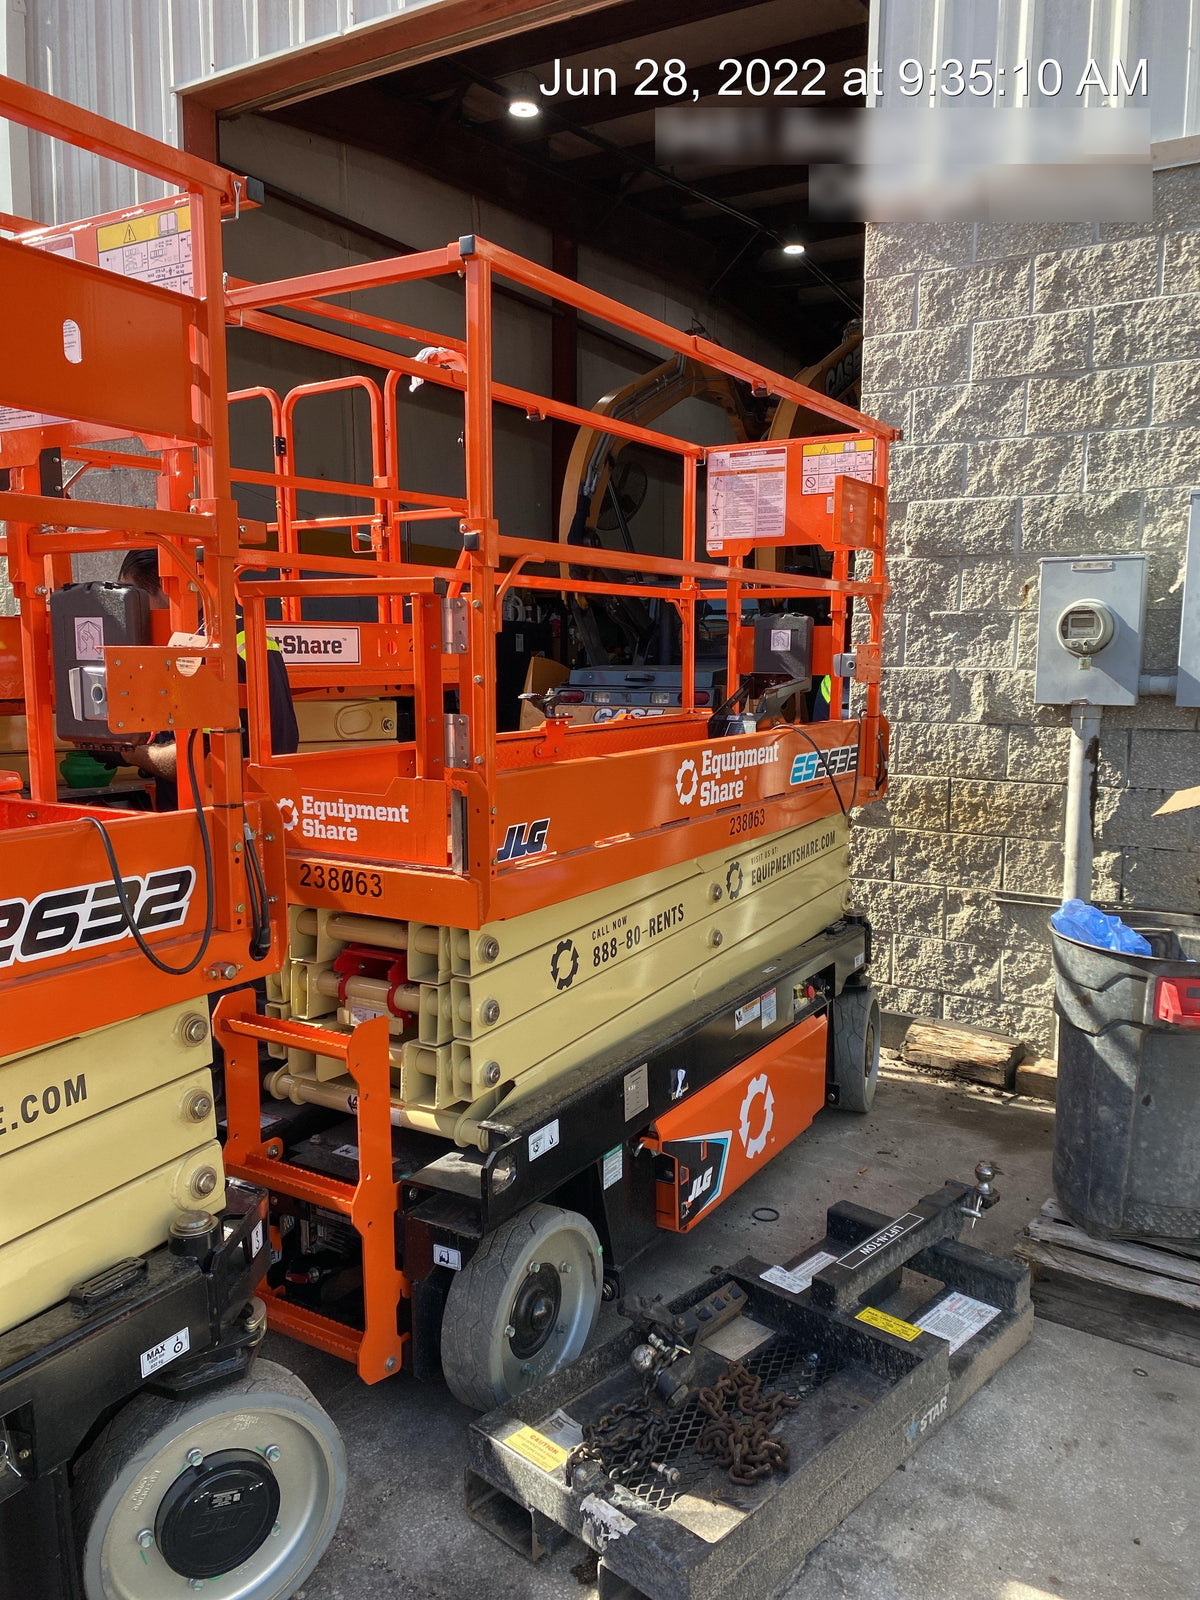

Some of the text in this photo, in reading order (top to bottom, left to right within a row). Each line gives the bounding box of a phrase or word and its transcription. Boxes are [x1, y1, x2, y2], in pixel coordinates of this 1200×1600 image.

[701, 741, 780, 780] Equipment
[301, 795, 410, 823] Equipment
[700, 779, 745, 807] Share
[301, 818, 358, 842] Share
[496, 817, 551, 863] JLG
[751, 830, 836, 887] EQUIPMENTSHARE.COM
[591, 915, 628, 941] CALL NOW
[592, 903, 685, 968] 888-80-RENTS
[687, 1166, 714, 1203] JLG
[146, 1343, 166, 1361] MAX
[920, 1395, 948, 1432] STAR
[529, 1434, 559, 1455] CAUTION
